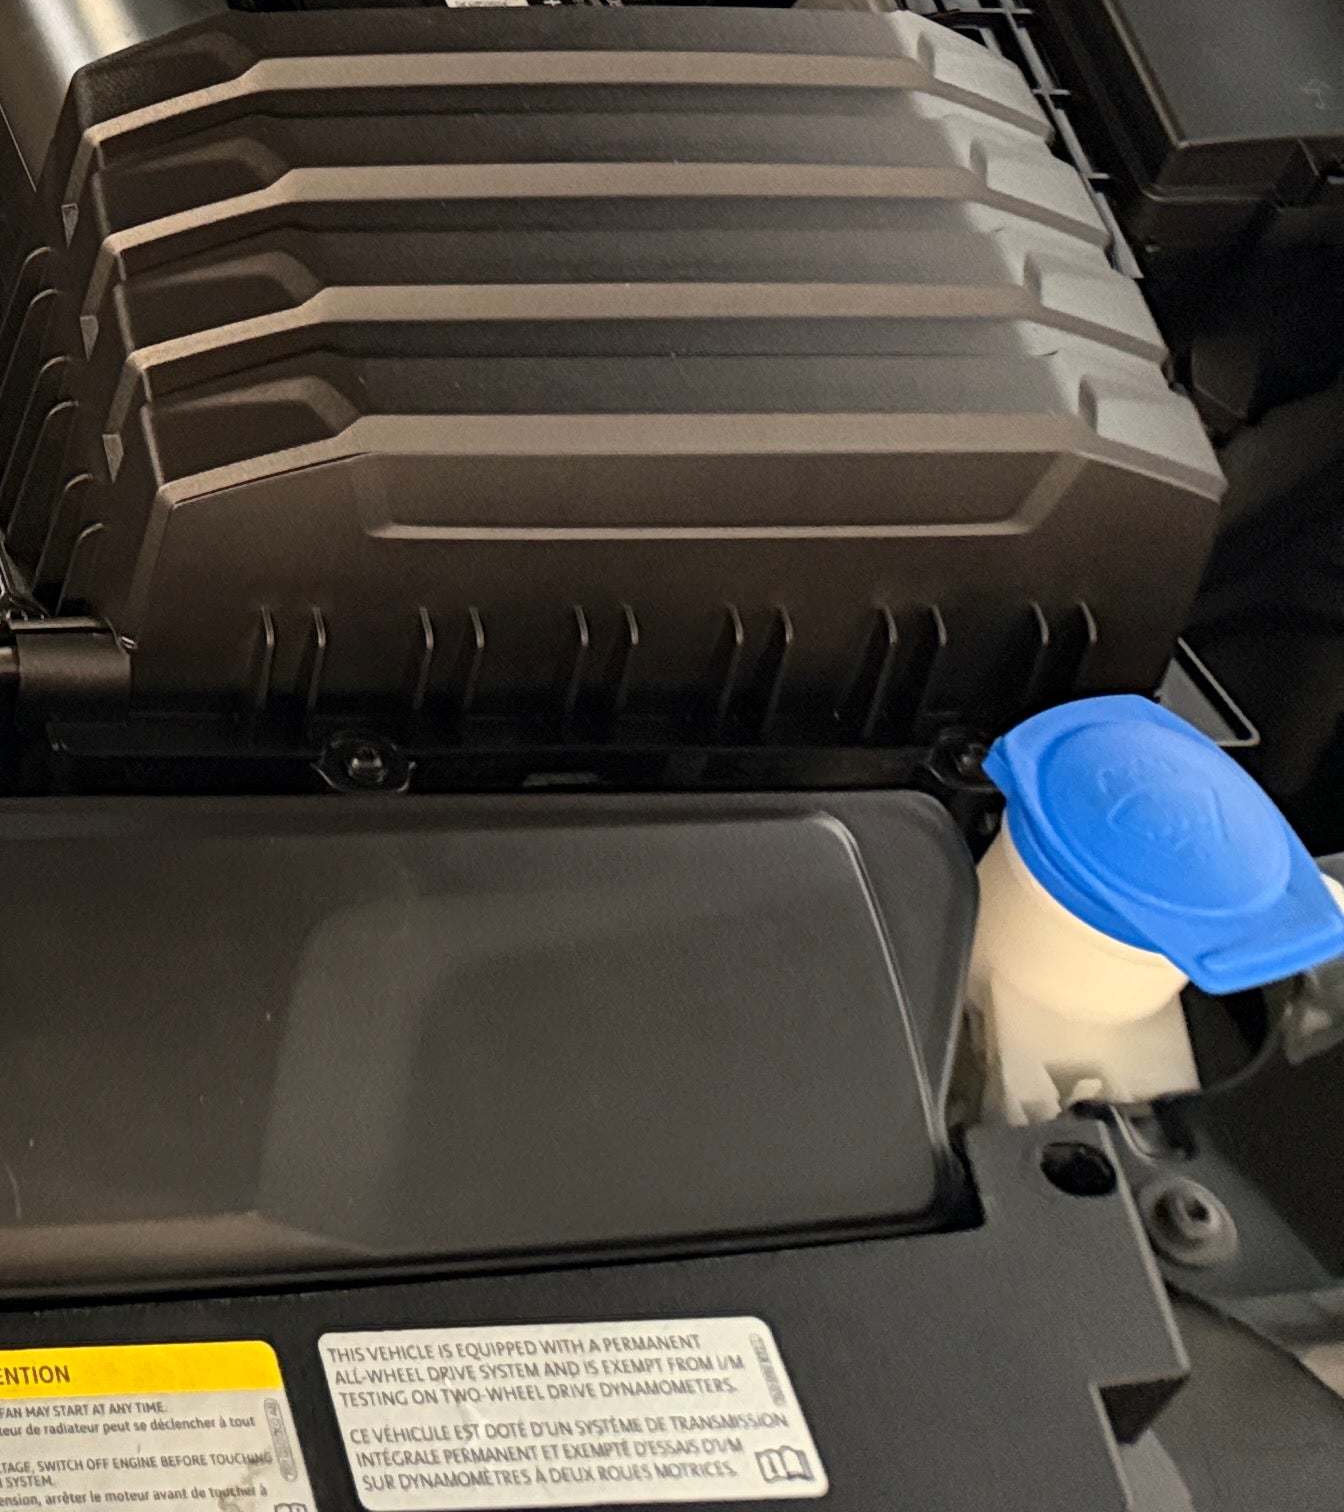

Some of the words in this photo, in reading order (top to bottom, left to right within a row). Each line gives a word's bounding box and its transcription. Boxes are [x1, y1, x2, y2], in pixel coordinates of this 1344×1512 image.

[325, 1346, 366, 1364] THIS
[365, 1343, 435, 1363] VEHICLE
[437, 1343, 454, 1359] IS
[455, 1339, 538, 1360] EQUIPPED
[537, 1338, 586, 1356] WITH
[588, 1338, 602, 1354] A
[601, 1333, 701, 1353] PERMANENT
[335, 1367, 426, 1386] ALL-WHEEL
[426, 1364, 477, 1384] DRIVE
[478, 1361, 542, 1381] SYSTEM
[543, 1360, 581, 1379] AND
[582, 1359, 600, 1376] IS
[600, 1357, 664, 1376] EXEMPT
[666, 1354, 715, 1373] FROM
[338, 1389, 409, 1409] TESTING
[411, 1388, 440, 1406] ON
[439, 1384, 546, 1405] TWO-WHEEL
[546, 1382, 597, 1401] DRIVE
[24, 1405, 51, 1419] MAY
[52, 1403, 89, 1418] START
[91, 1402, 106, 1417] AT
[108, 1402, 133, 1416] ANY
[25, 1422, 42, 1436] de
[43, 1421, 100, 1436] radiateur
[102, 1420, 132, 1436] peut
[132, 1421, 148, 1433] se
[149, 1416, 216, 1432] déclencher
[218, 1414, 228, 1429] à
[228, 1415, 256, 1429] tout
[349, 1427, 371, 1446] CE
[371, 1423, 452, 1444] VÉHICULE
[453, 1420, 481, 1443] EST
[483, 1418, 529, 1441] DOTÉ
[528, 1420, 574, 1439] D'UN
[643, 1416, 668, 1434] DE
[668, 1411, 790, 1431] TRANSMISSION
[36, 1458, 85, 1473] SWITCH
[85, 1457, 110, 1471] OFF
[111, 1455, 159, 1471] ENGINE
[159, 1453, 209, 1469] BEFORE
[208, 1451, 274, 1469] TOUCHING
[442, 1443, 539, 1465] PERMANENT
[540, 1443, 560, 1462] ET
[361, 1471, 397, 1493] SUR
[535, 1465, 548, 1484] À
[547, 1465, 596, 1485] DEUX
[595, 1463, 653, 1482] ROUES
[44, 1490, 87, 1506] arrêter
[88, 1489, 102, 1504] le
[104, 1490, 150, 1503] moteur
[152, 1487, 190, 1501] avant
[190, 1485, 207, 1500] de
[259, 1483, 269, 1498] à
